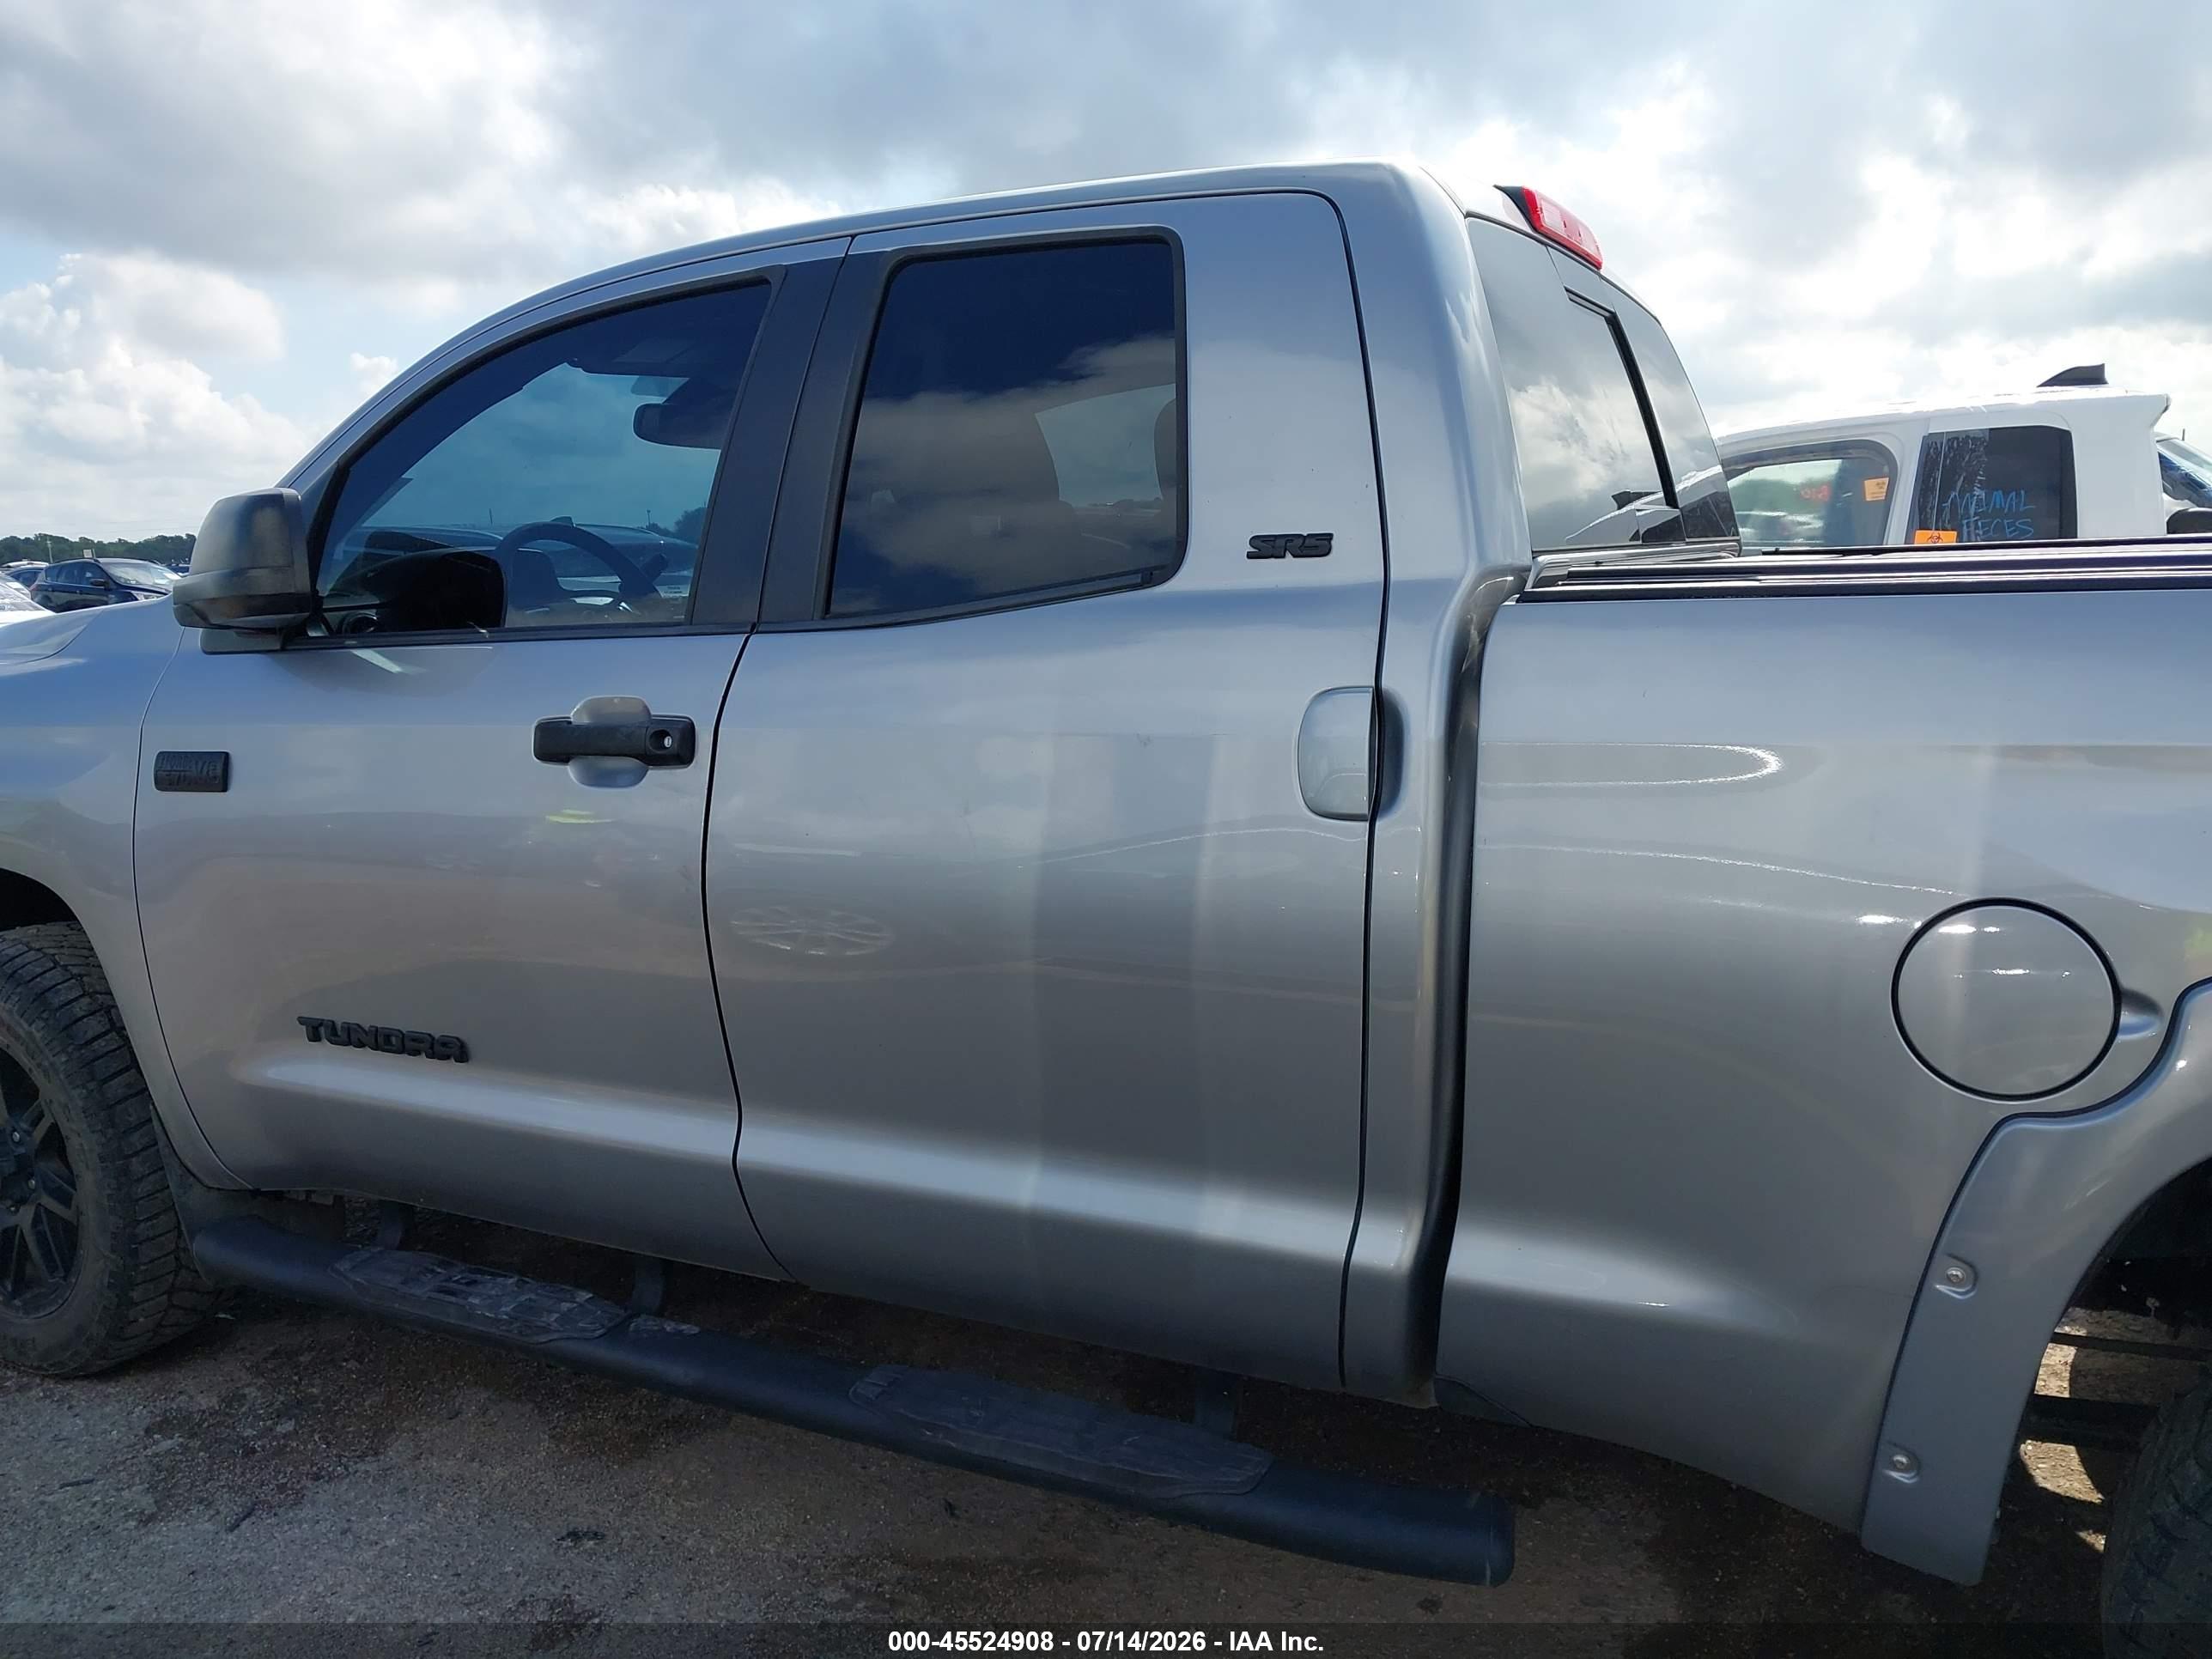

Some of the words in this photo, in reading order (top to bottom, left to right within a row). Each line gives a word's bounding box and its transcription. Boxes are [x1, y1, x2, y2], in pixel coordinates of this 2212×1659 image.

[1942, 489, 2036, 519] ANIMAL
[1962, 516, 2034, 542] FECES
[297, 1016, 470, 1063] TUNDRA
